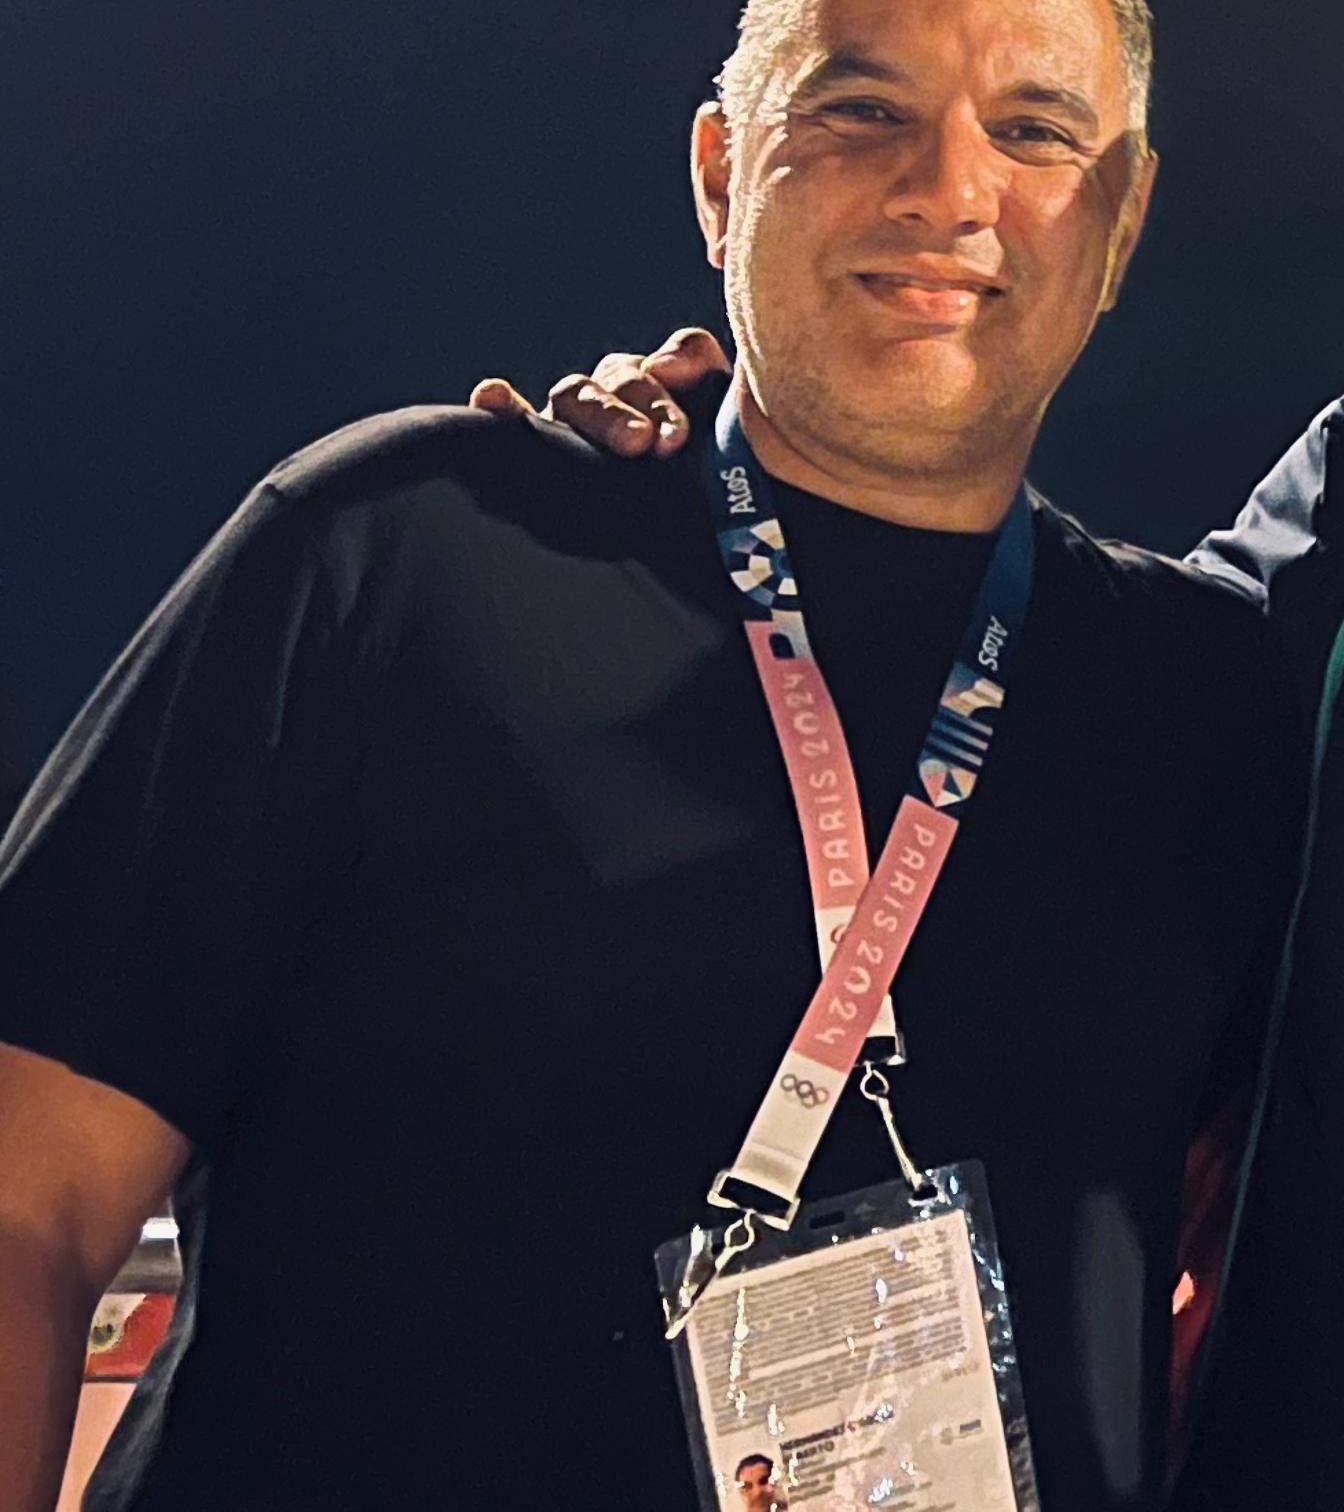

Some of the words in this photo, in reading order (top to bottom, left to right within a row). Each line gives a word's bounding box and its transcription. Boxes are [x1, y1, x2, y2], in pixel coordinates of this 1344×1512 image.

[719, 465, 756, 515] Atos
[977, 615, 1009, 671] Atos
[780, 672, 830, 758] 2024
[807, 768, 855, 889] PARIS
[872, 822, 937, 936] PARIS
[815, 942, 886, 1048] 2024
